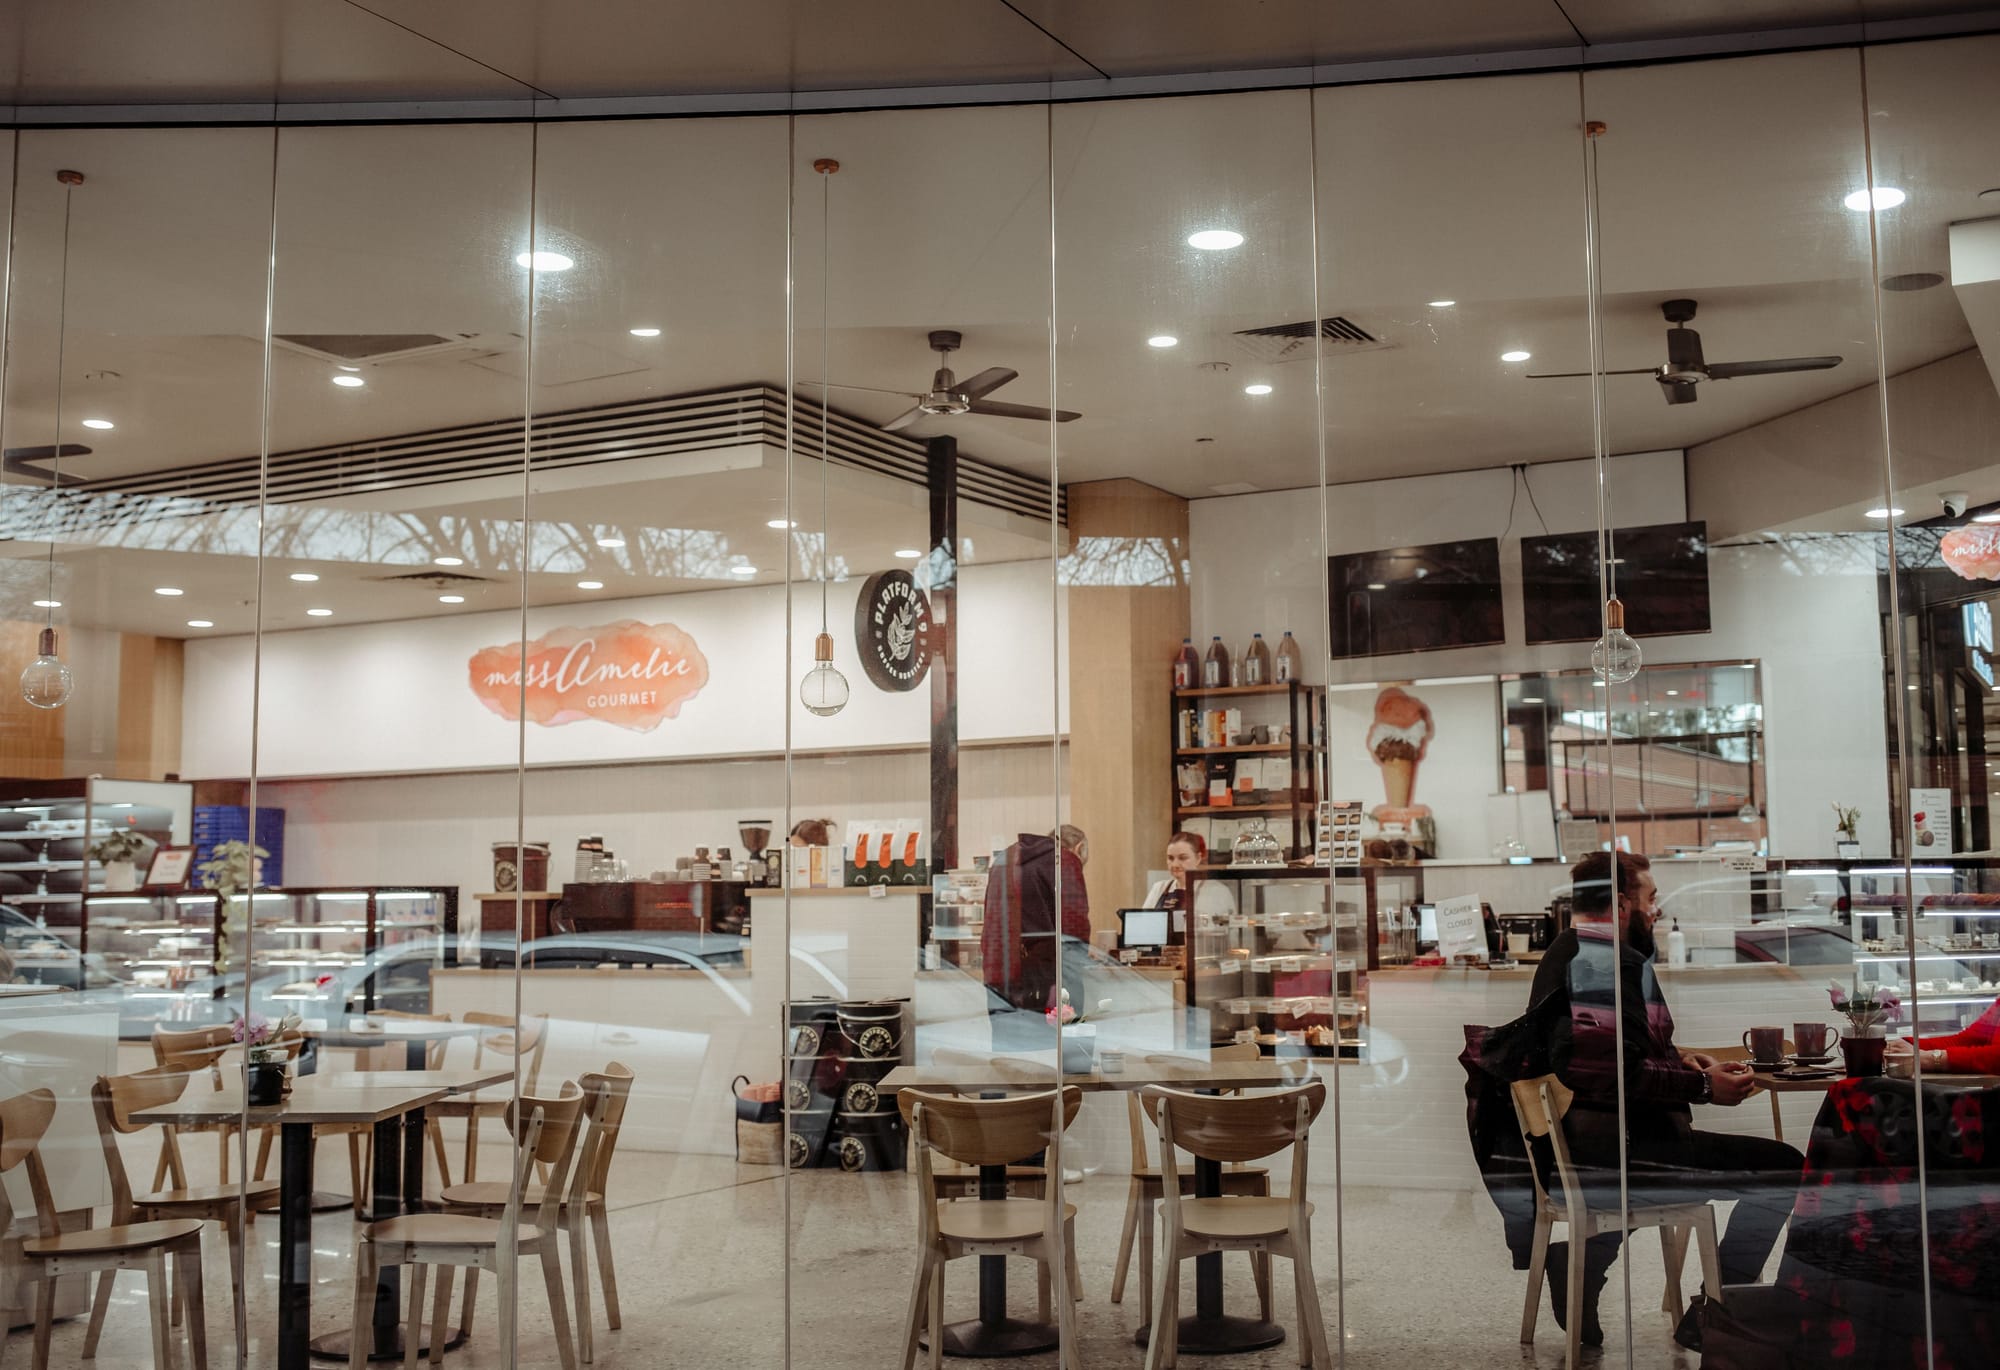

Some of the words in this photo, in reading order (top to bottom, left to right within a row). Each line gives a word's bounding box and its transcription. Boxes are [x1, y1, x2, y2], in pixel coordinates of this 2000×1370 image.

[874, 581, 925, 626] PLATFORM
[586, 690, 657, 709] GOURMET
[1447, 918, 1473, 929] CLOSED
